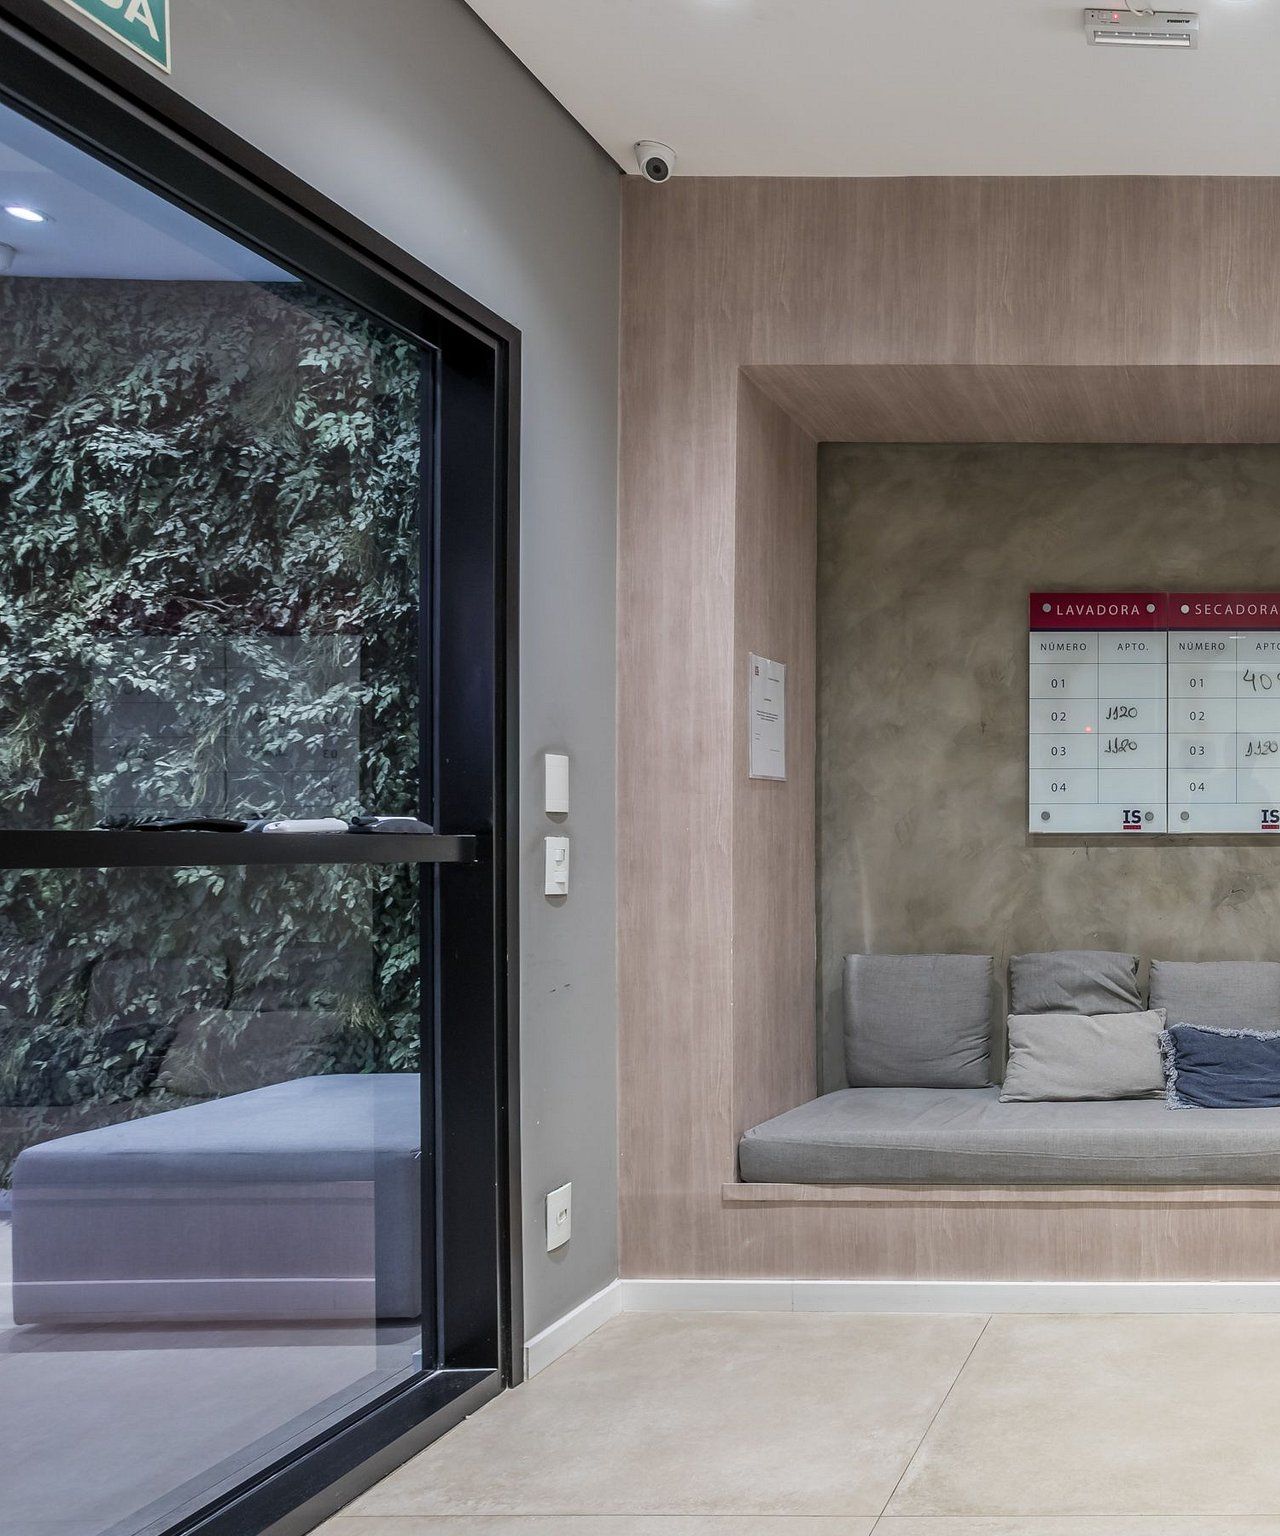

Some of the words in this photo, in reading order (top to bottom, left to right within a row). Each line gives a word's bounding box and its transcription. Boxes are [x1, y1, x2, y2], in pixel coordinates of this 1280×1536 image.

[1057, 604, 1140, 616] LAVADORA
[1195, 604, 1278, 615] SECADORA
[1040, 641, 1087, 651] NÚMERO
[1117, 643, 1149, 651] APTO.
[1179, 641, 1225, 650] NÚMERO
[1051, 679, 1066, 688] 01
[1189, 679, 1204, 687] 01
[1051, 712, 1066, 721] 02
[1189, 712, 1205, 721] 02
[1051, 747, 1066, 755] 03
[1189, 746, 1205, 755] 03
[1051, 783, 1066, 792] 04
[1189, 783, 1205, 791] 04
[1123, 810, 1141, 824] IS
[1261, 810, 1279, 823] IS
